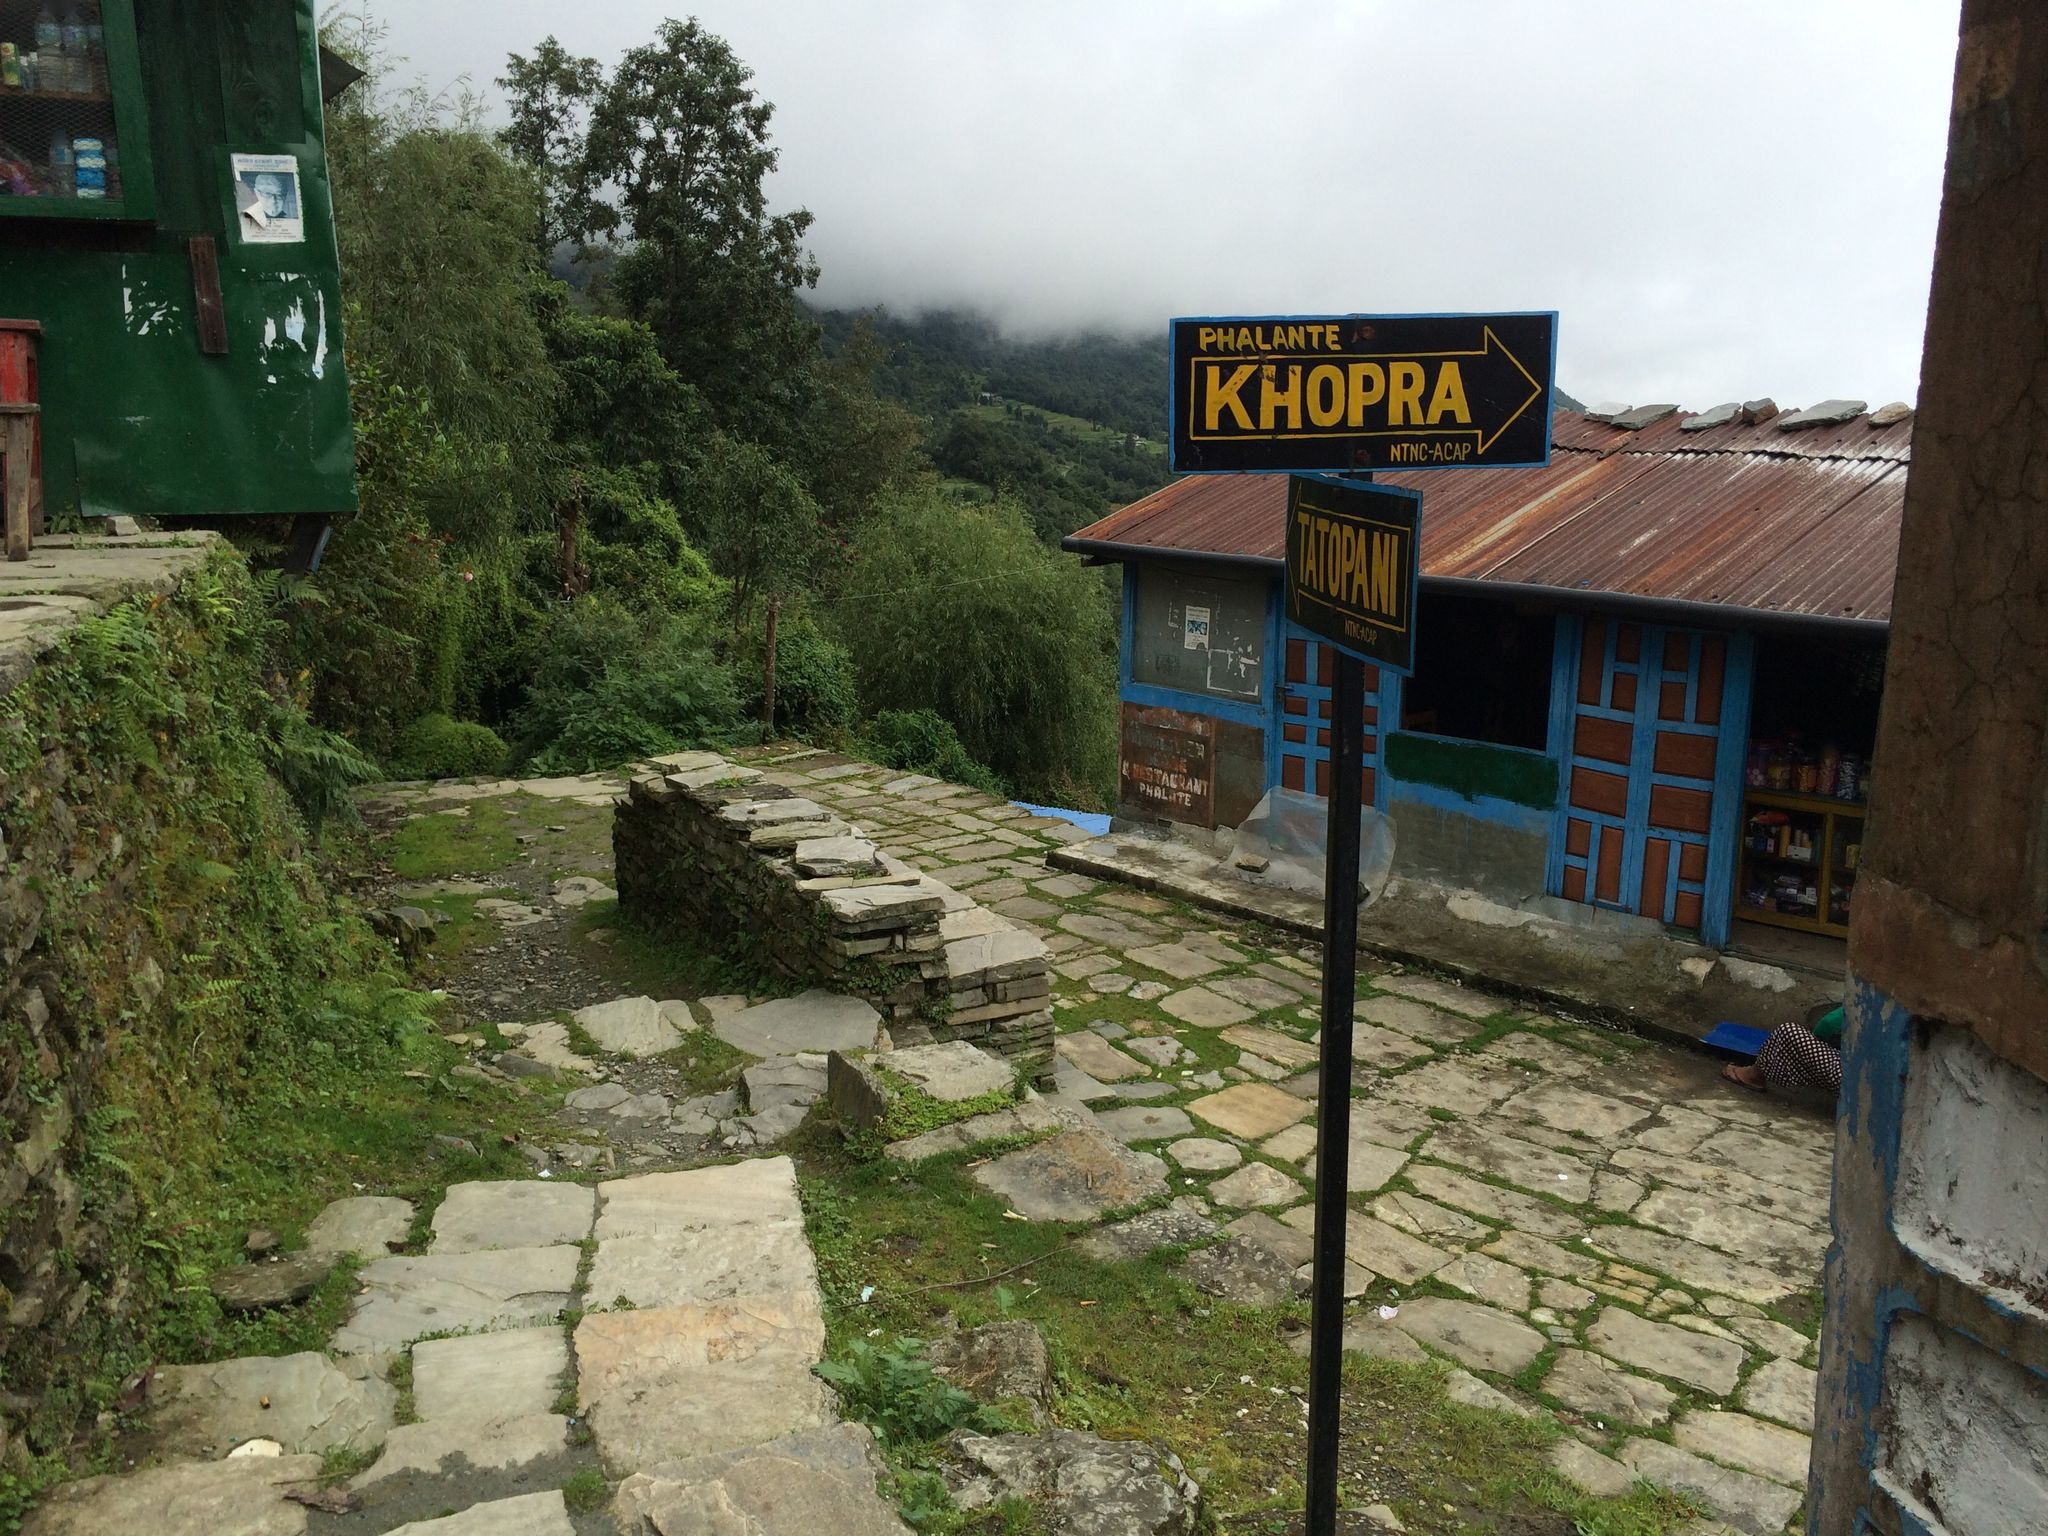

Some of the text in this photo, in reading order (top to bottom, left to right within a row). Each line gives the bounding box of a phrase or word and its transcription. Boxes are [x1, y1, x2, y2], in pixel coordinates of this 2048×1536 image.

[1199, 324, 1342, 351] PHALANTE
[1204, 361, 1472, 430] KHOPRA
[1390, 442, 1472, 463] NTNC-ACAP
[1297, 511, 1399, 617] TATOPANI
